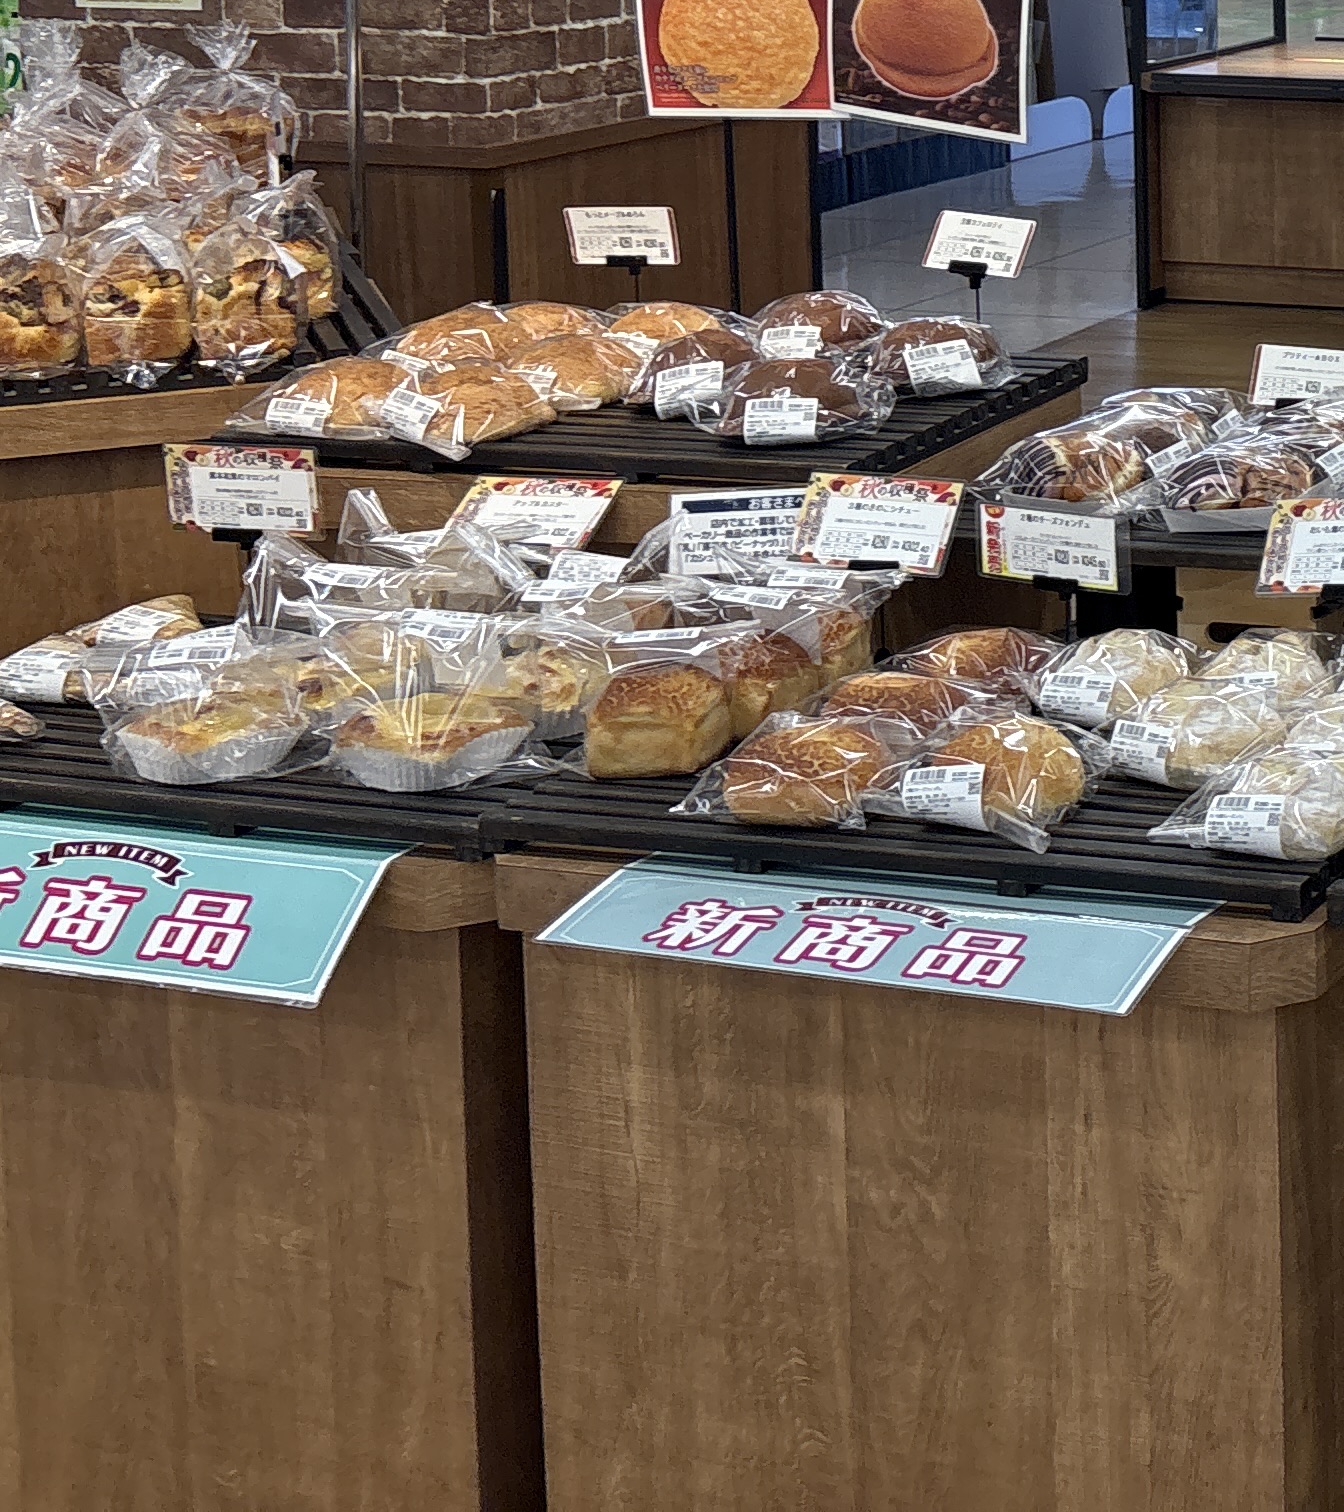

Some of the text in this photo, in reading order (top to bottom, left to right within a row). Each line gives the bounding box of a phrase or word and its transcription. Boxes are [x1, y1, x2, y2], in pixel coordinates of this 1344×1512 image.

[63, 844, 169, 870] NEW ITEM
[641, 896, 1028, 989] 新商品
